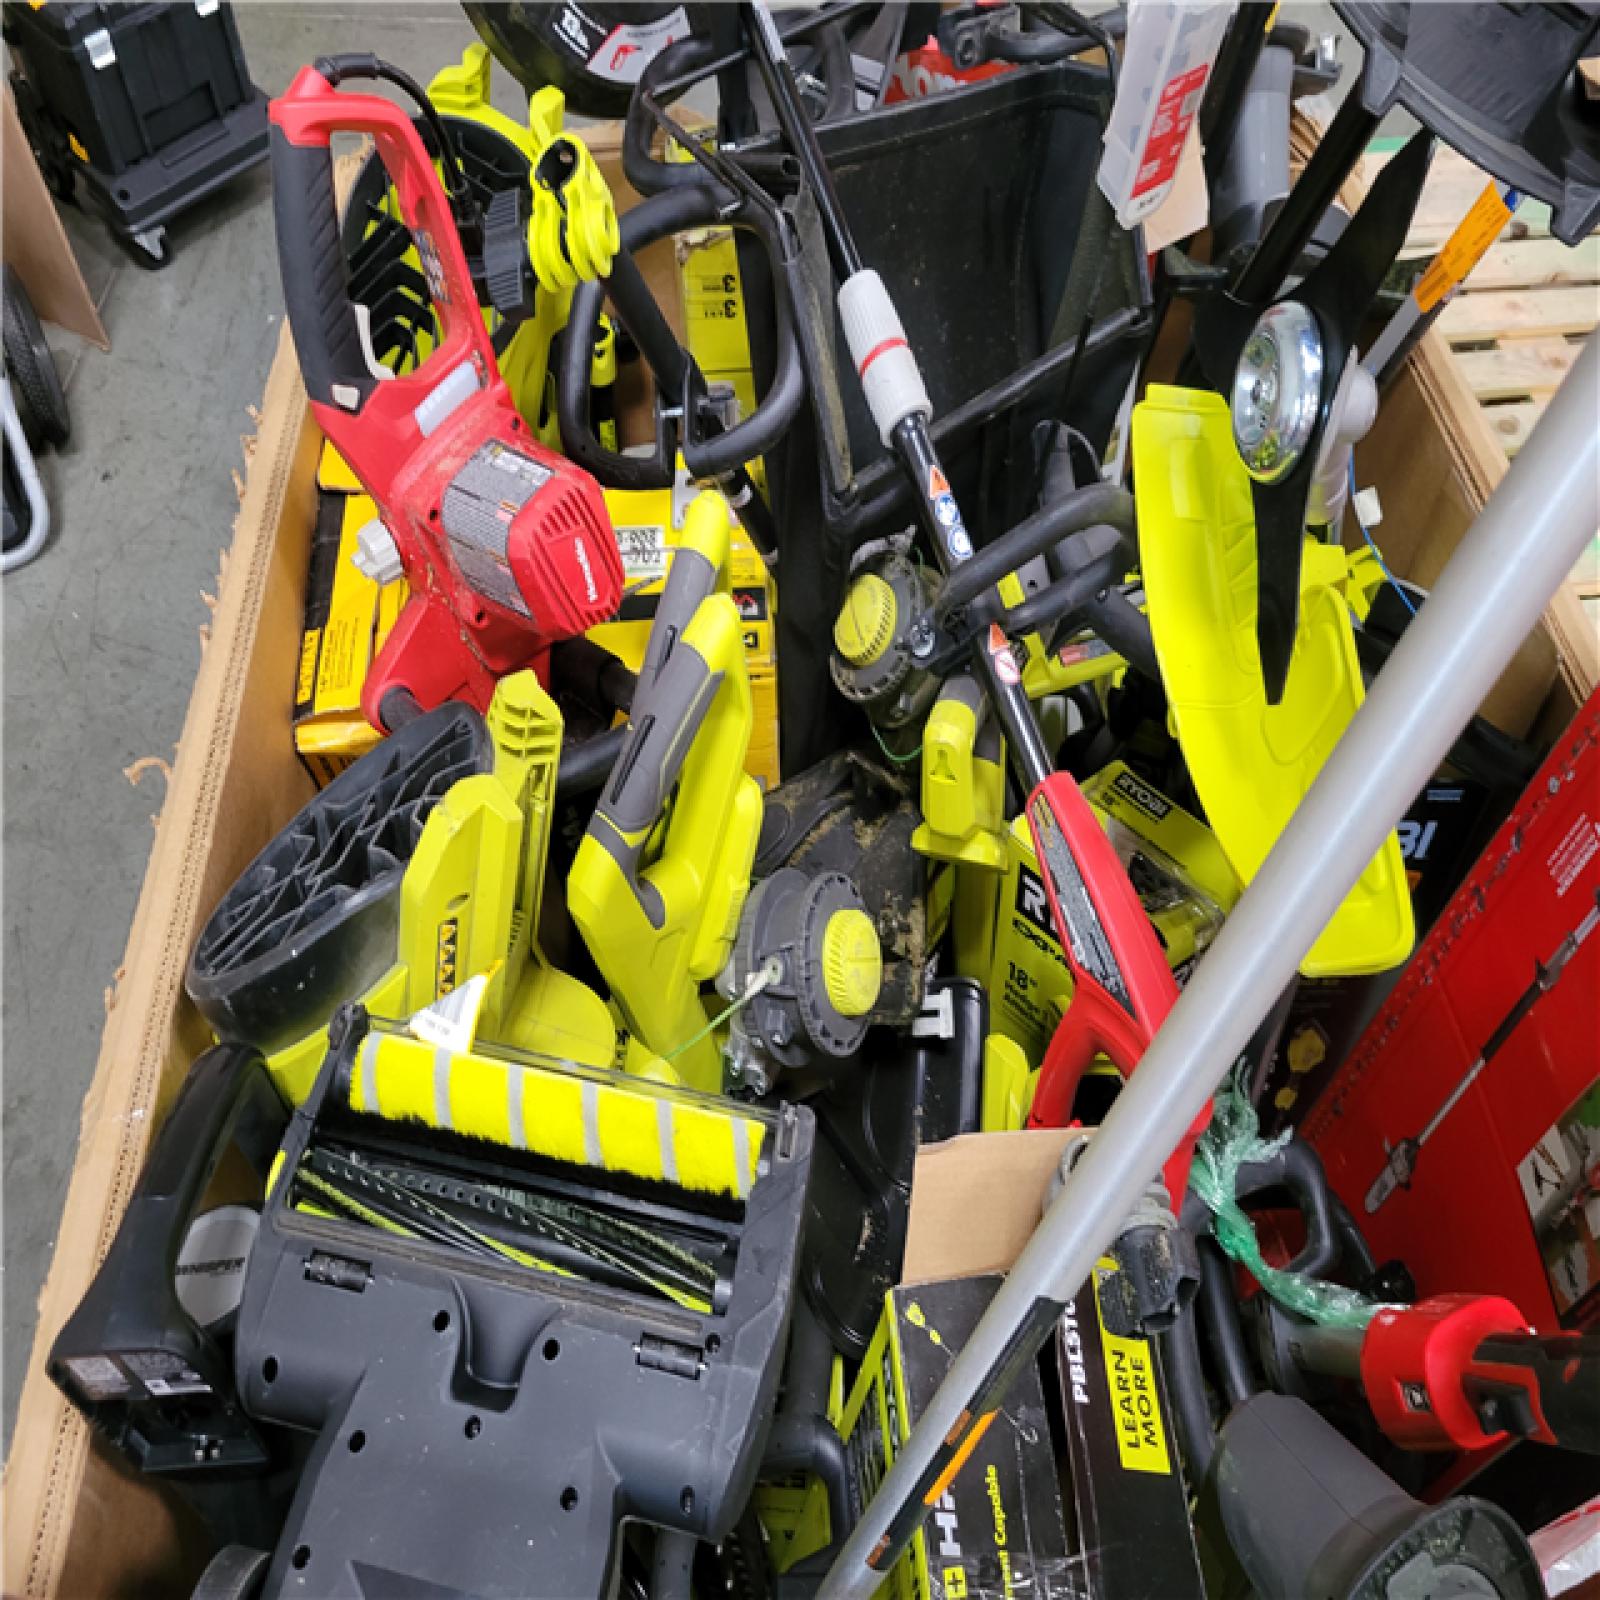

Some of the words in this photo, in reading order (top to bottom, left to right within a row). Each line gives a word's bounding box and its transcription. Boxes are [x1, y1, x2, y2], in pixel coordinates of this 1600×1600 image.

[1111, 1349, 1141, 1449] LEARN
[1130, 1356, 1158, 1447] MORE
[984, 1464, 1007, 1546] Capable
